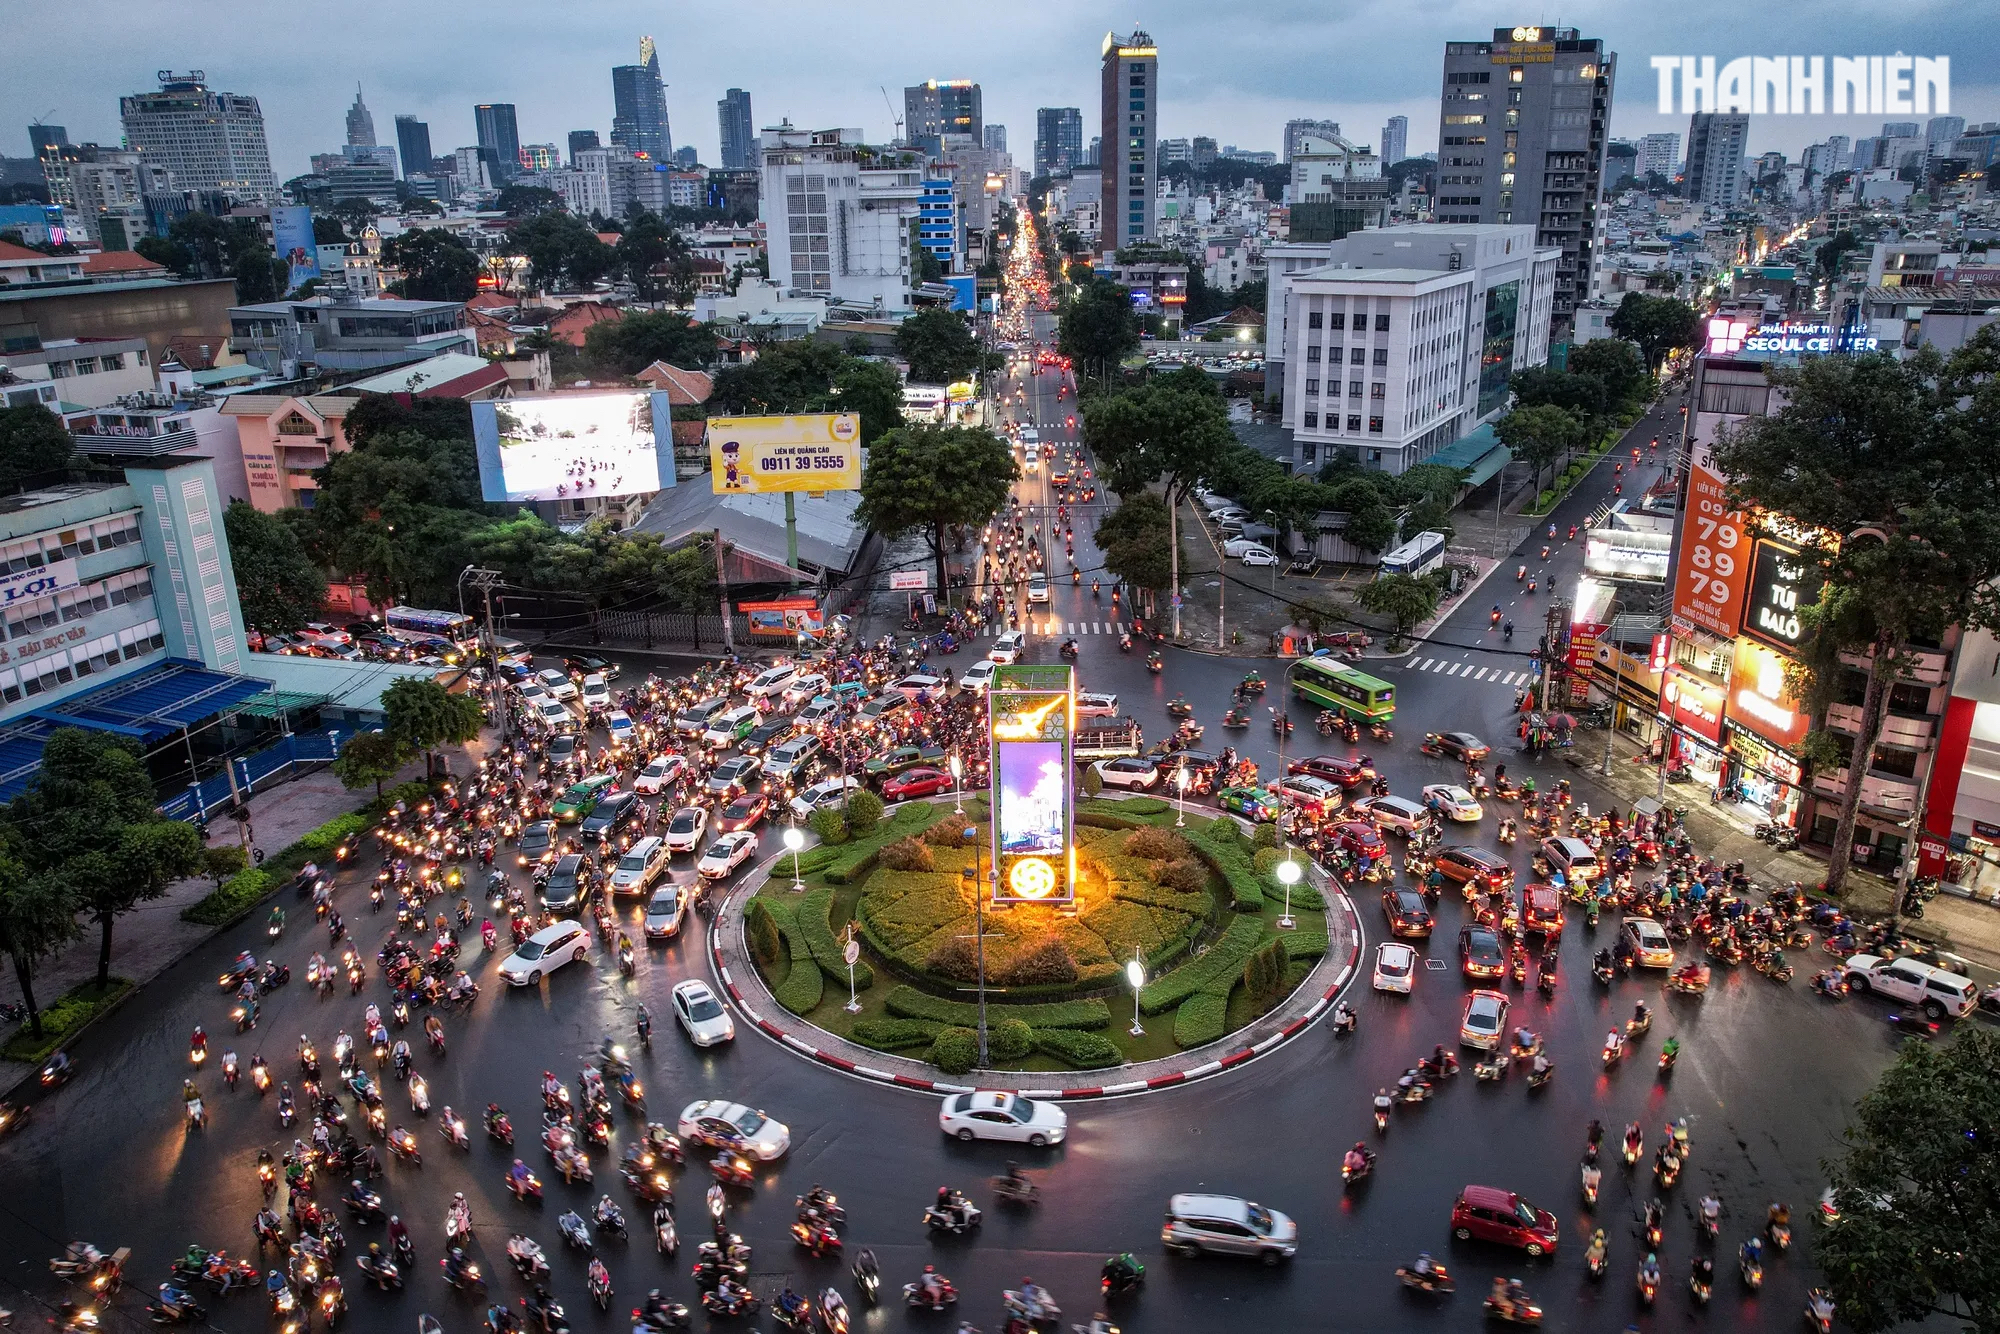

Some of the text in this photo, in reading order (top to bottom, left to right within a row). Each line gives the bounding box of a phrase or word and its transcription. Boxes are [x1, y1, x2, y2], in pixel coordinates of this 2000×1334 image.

[1746, 337, 1804, 351] SEOUL
[108, 425, 149, 437] VIETNAM
[761, 455, 844, 471] 0911 39 5555
[774, 445, 830, 456] LIÊN HỆ QUẢNG CÁO
[1697, 482, 1709, 493] LIÊN
[1697, 517, 1738, 549] 79
[1692, 545, 1735, 577] 89
[3, 576, 59, 601] LỢI
[1690, 570, 1730, 604] 79
[1771, 583, 1797, 612] TÚI
[1759, 607, 1800, 640] BALÔ
